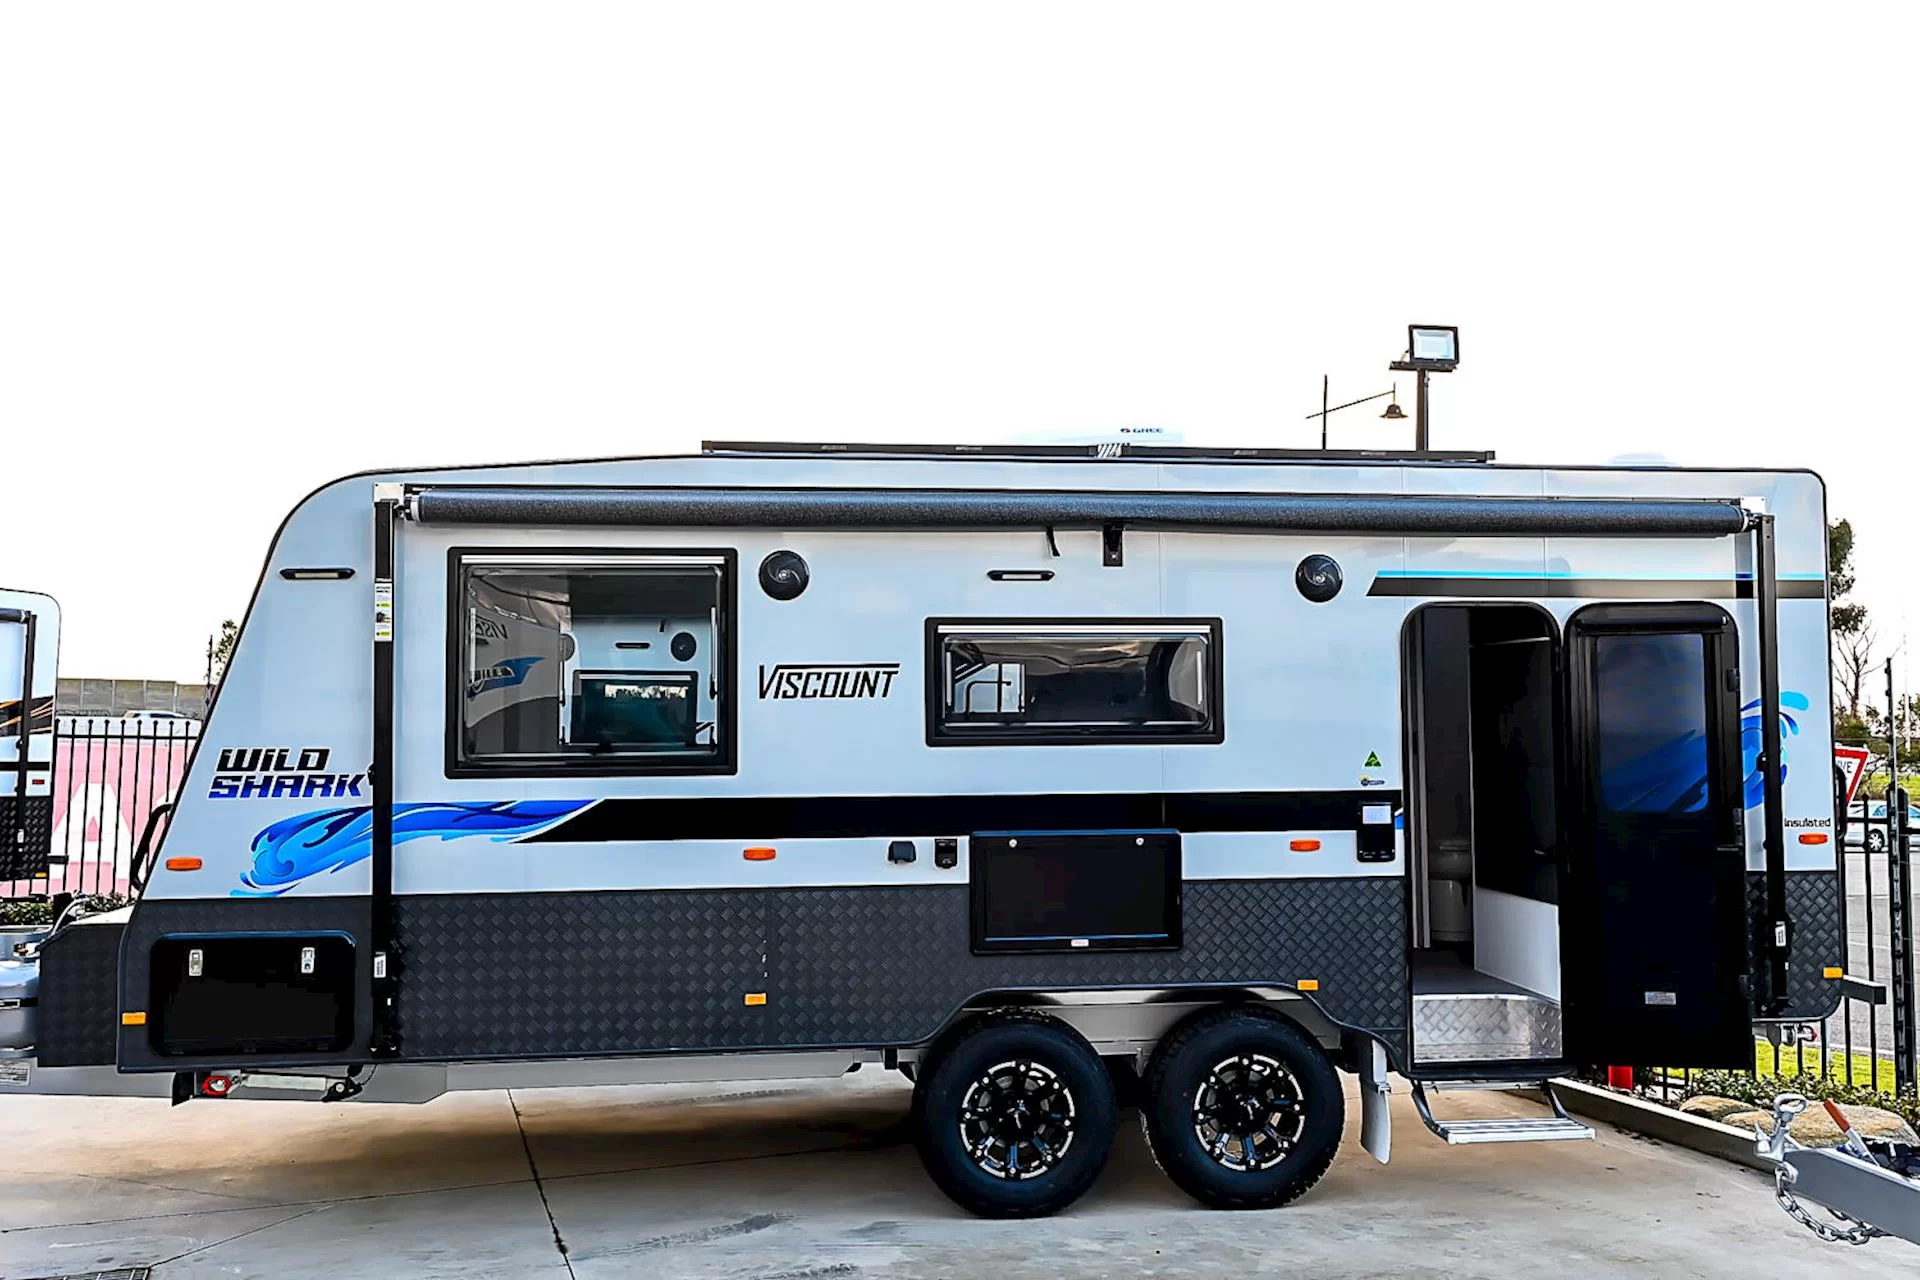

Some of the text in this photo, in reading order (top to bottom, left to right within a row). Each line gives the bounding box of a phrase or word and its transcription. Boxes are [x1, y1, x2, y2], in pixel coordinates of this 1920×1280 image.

[758, 662, 901, 700] VISCOUNT
[215, 747, 331, 773] WILD
[207, 773, 366, 800] SHARK
[1784, 817, 1831, 828] insulated
